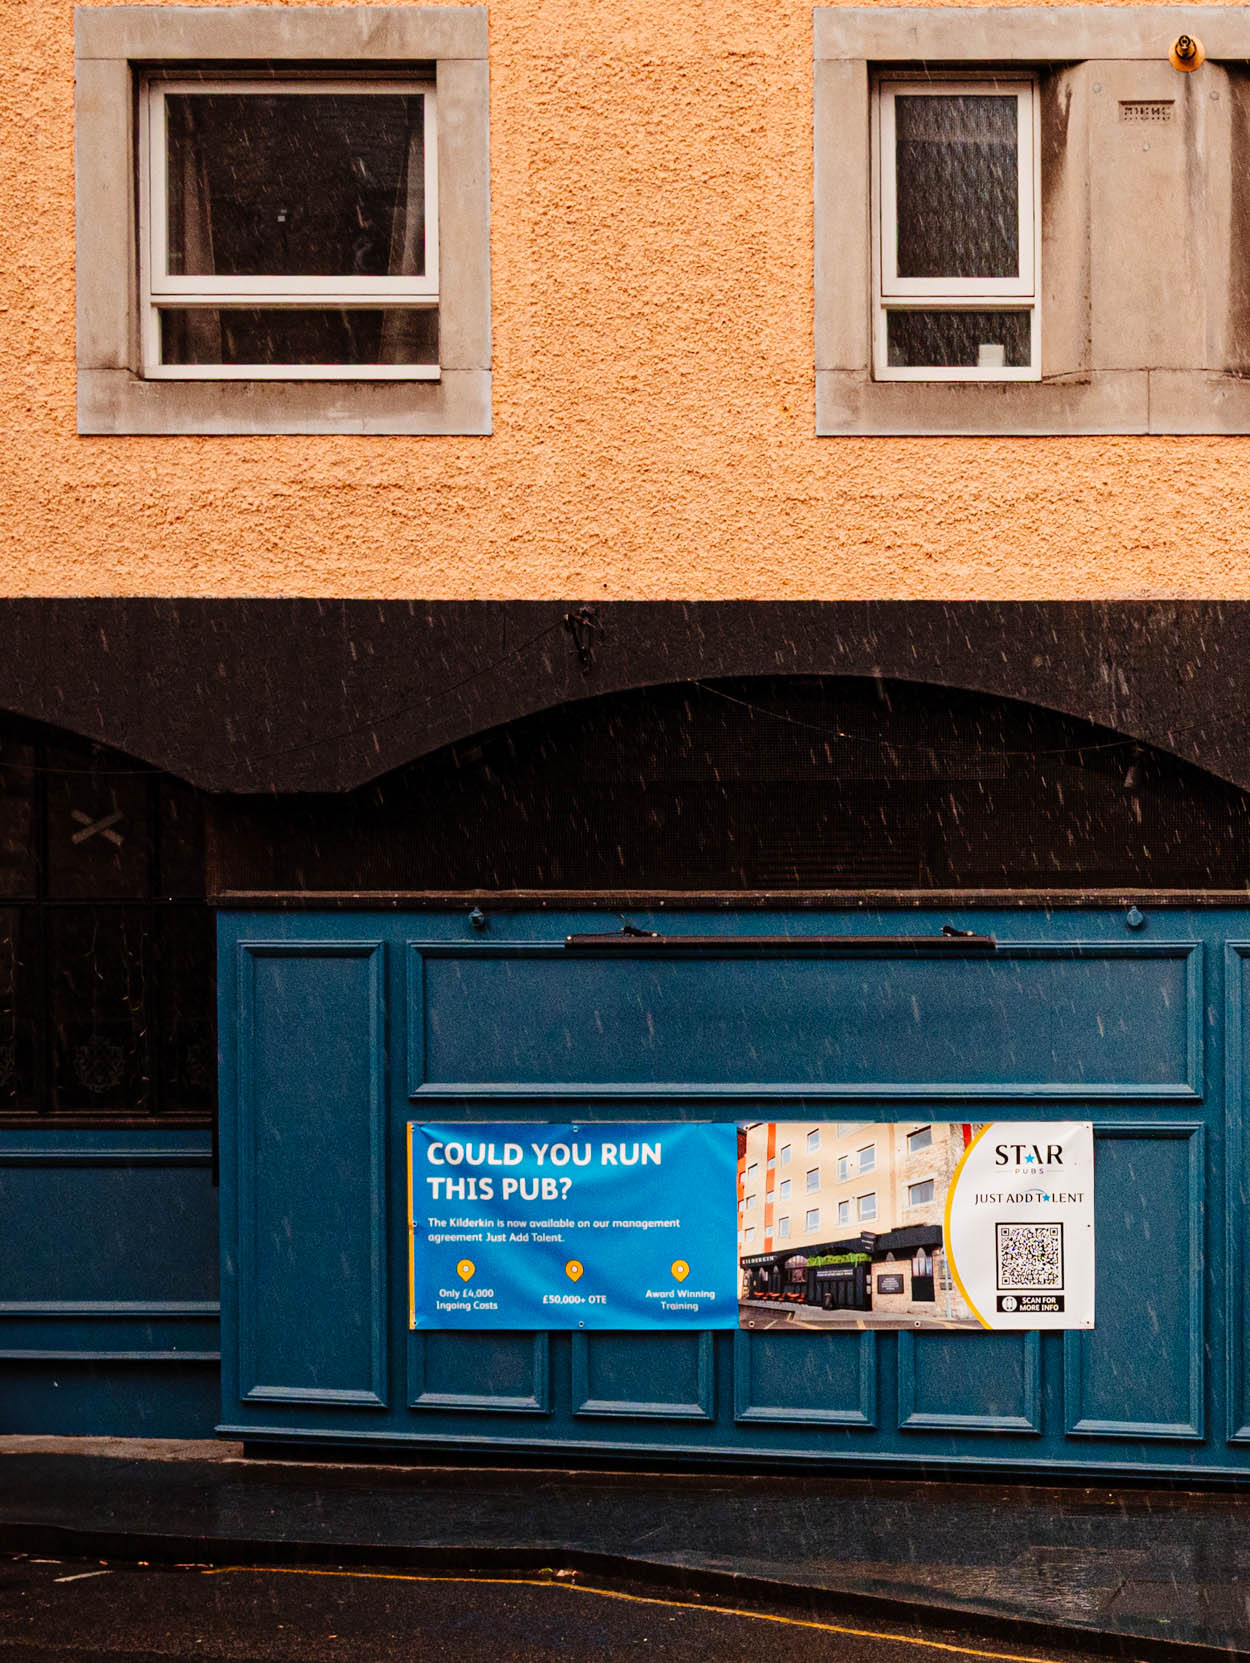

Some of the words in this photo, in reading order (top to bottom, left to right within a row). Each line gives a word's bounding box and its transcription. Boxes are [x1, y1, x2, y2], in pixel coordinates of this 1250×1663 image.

[427, 1142, 523, 1165] COULD
[532, 1144, 591, 1166] YOU
[601, 1143, 661, 1165] RUN
[995, 1144, 1064, 1165] STAR
[427, 1177, 493, 1200] THIS
[502, 1177, 572, 1200] PUB?
[975, 1193, 1003, 1205] JUST
[1006, 1193, 1034, 1204] ADD
[428, 1218, 447, 1227] The
[450, 1218, 494, 1227] Kilderkin
[530, 1219, 574, 1227] available
[613, 1219, 680, 1230] management
[428, 1233, 482, 1243] agreement
[487, 1233, 506, 1242] Just
[510, 1233, 529, 1241] Add
[532, 1233, 565, 1243] Talent.
[440, 1289, 460, 1299] Only
[463, 1289, 494, 1299] £4,000
[677, 1290, 715, 1300] Winning
[437, 1301, 471, 1311] Ingoing
[473, 1301, 498, 1309] Costs
[543, 1295, 585, 1306] £50,000+
[588, 1296, 606, 1304] OTE
[661, 1301, 698, 1312] Training
[1019, 1304, 1040, 1312] MORE
[1041, 1304, 1059, 1312] INFO
